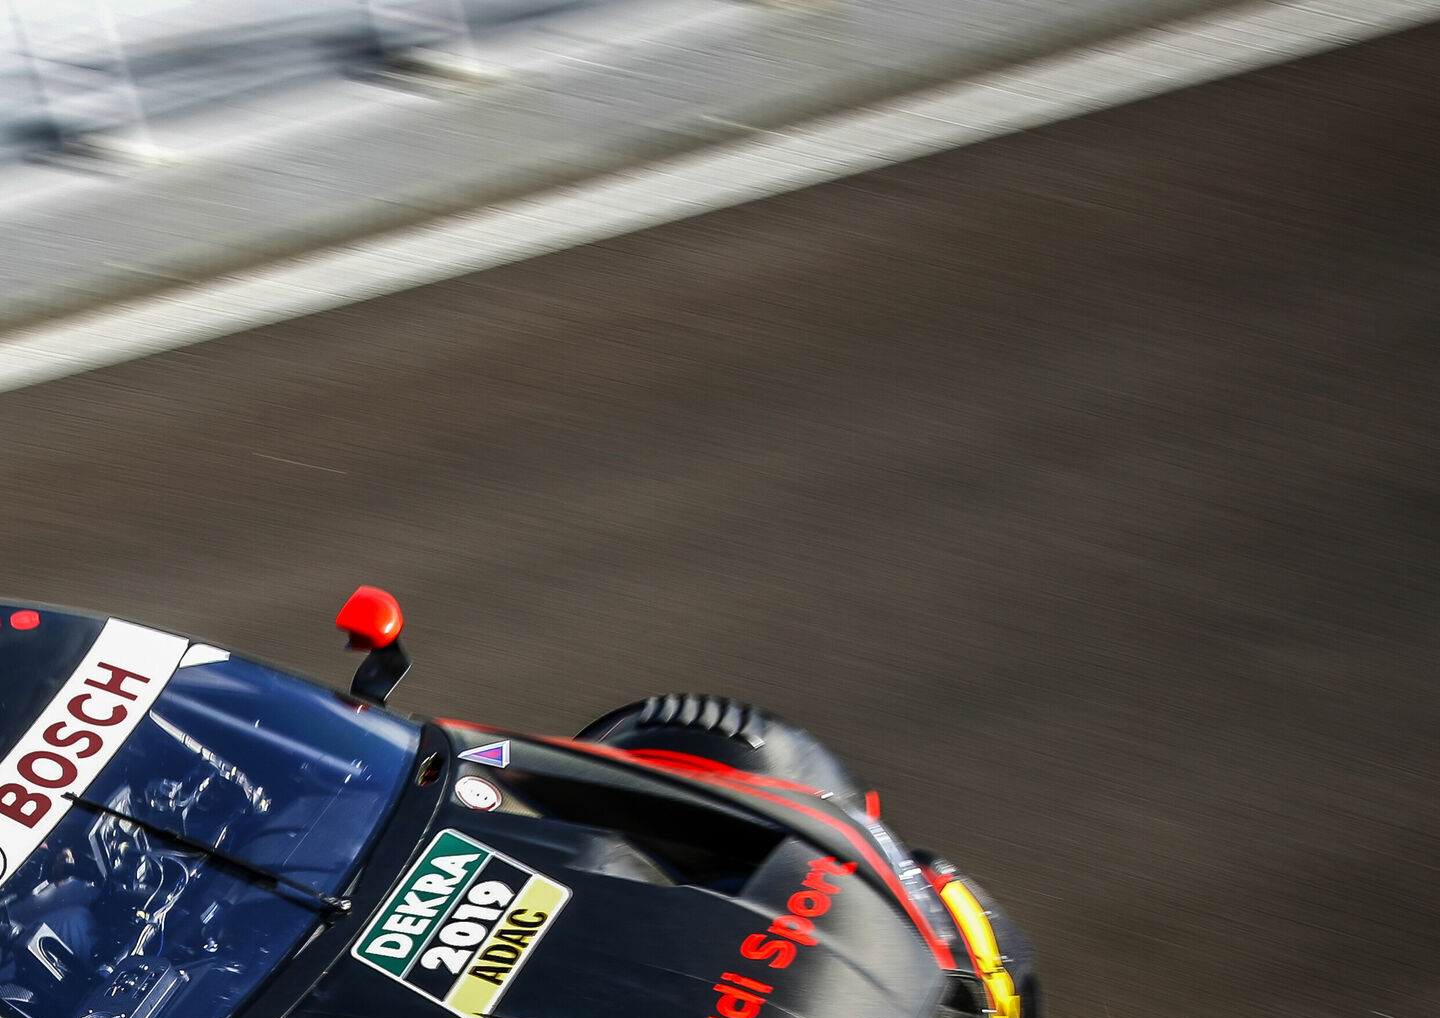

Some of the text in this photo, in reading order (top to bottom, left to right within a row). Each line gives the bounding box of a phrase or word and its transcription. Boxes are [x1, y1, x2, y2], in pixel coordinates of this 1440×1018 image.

[364, 852, 483, 960] DEKRA
[420, 880, 517, 975] 2019
[467, 908, 549, 987] ADAC
[739, 855, 857, 969] Sport
